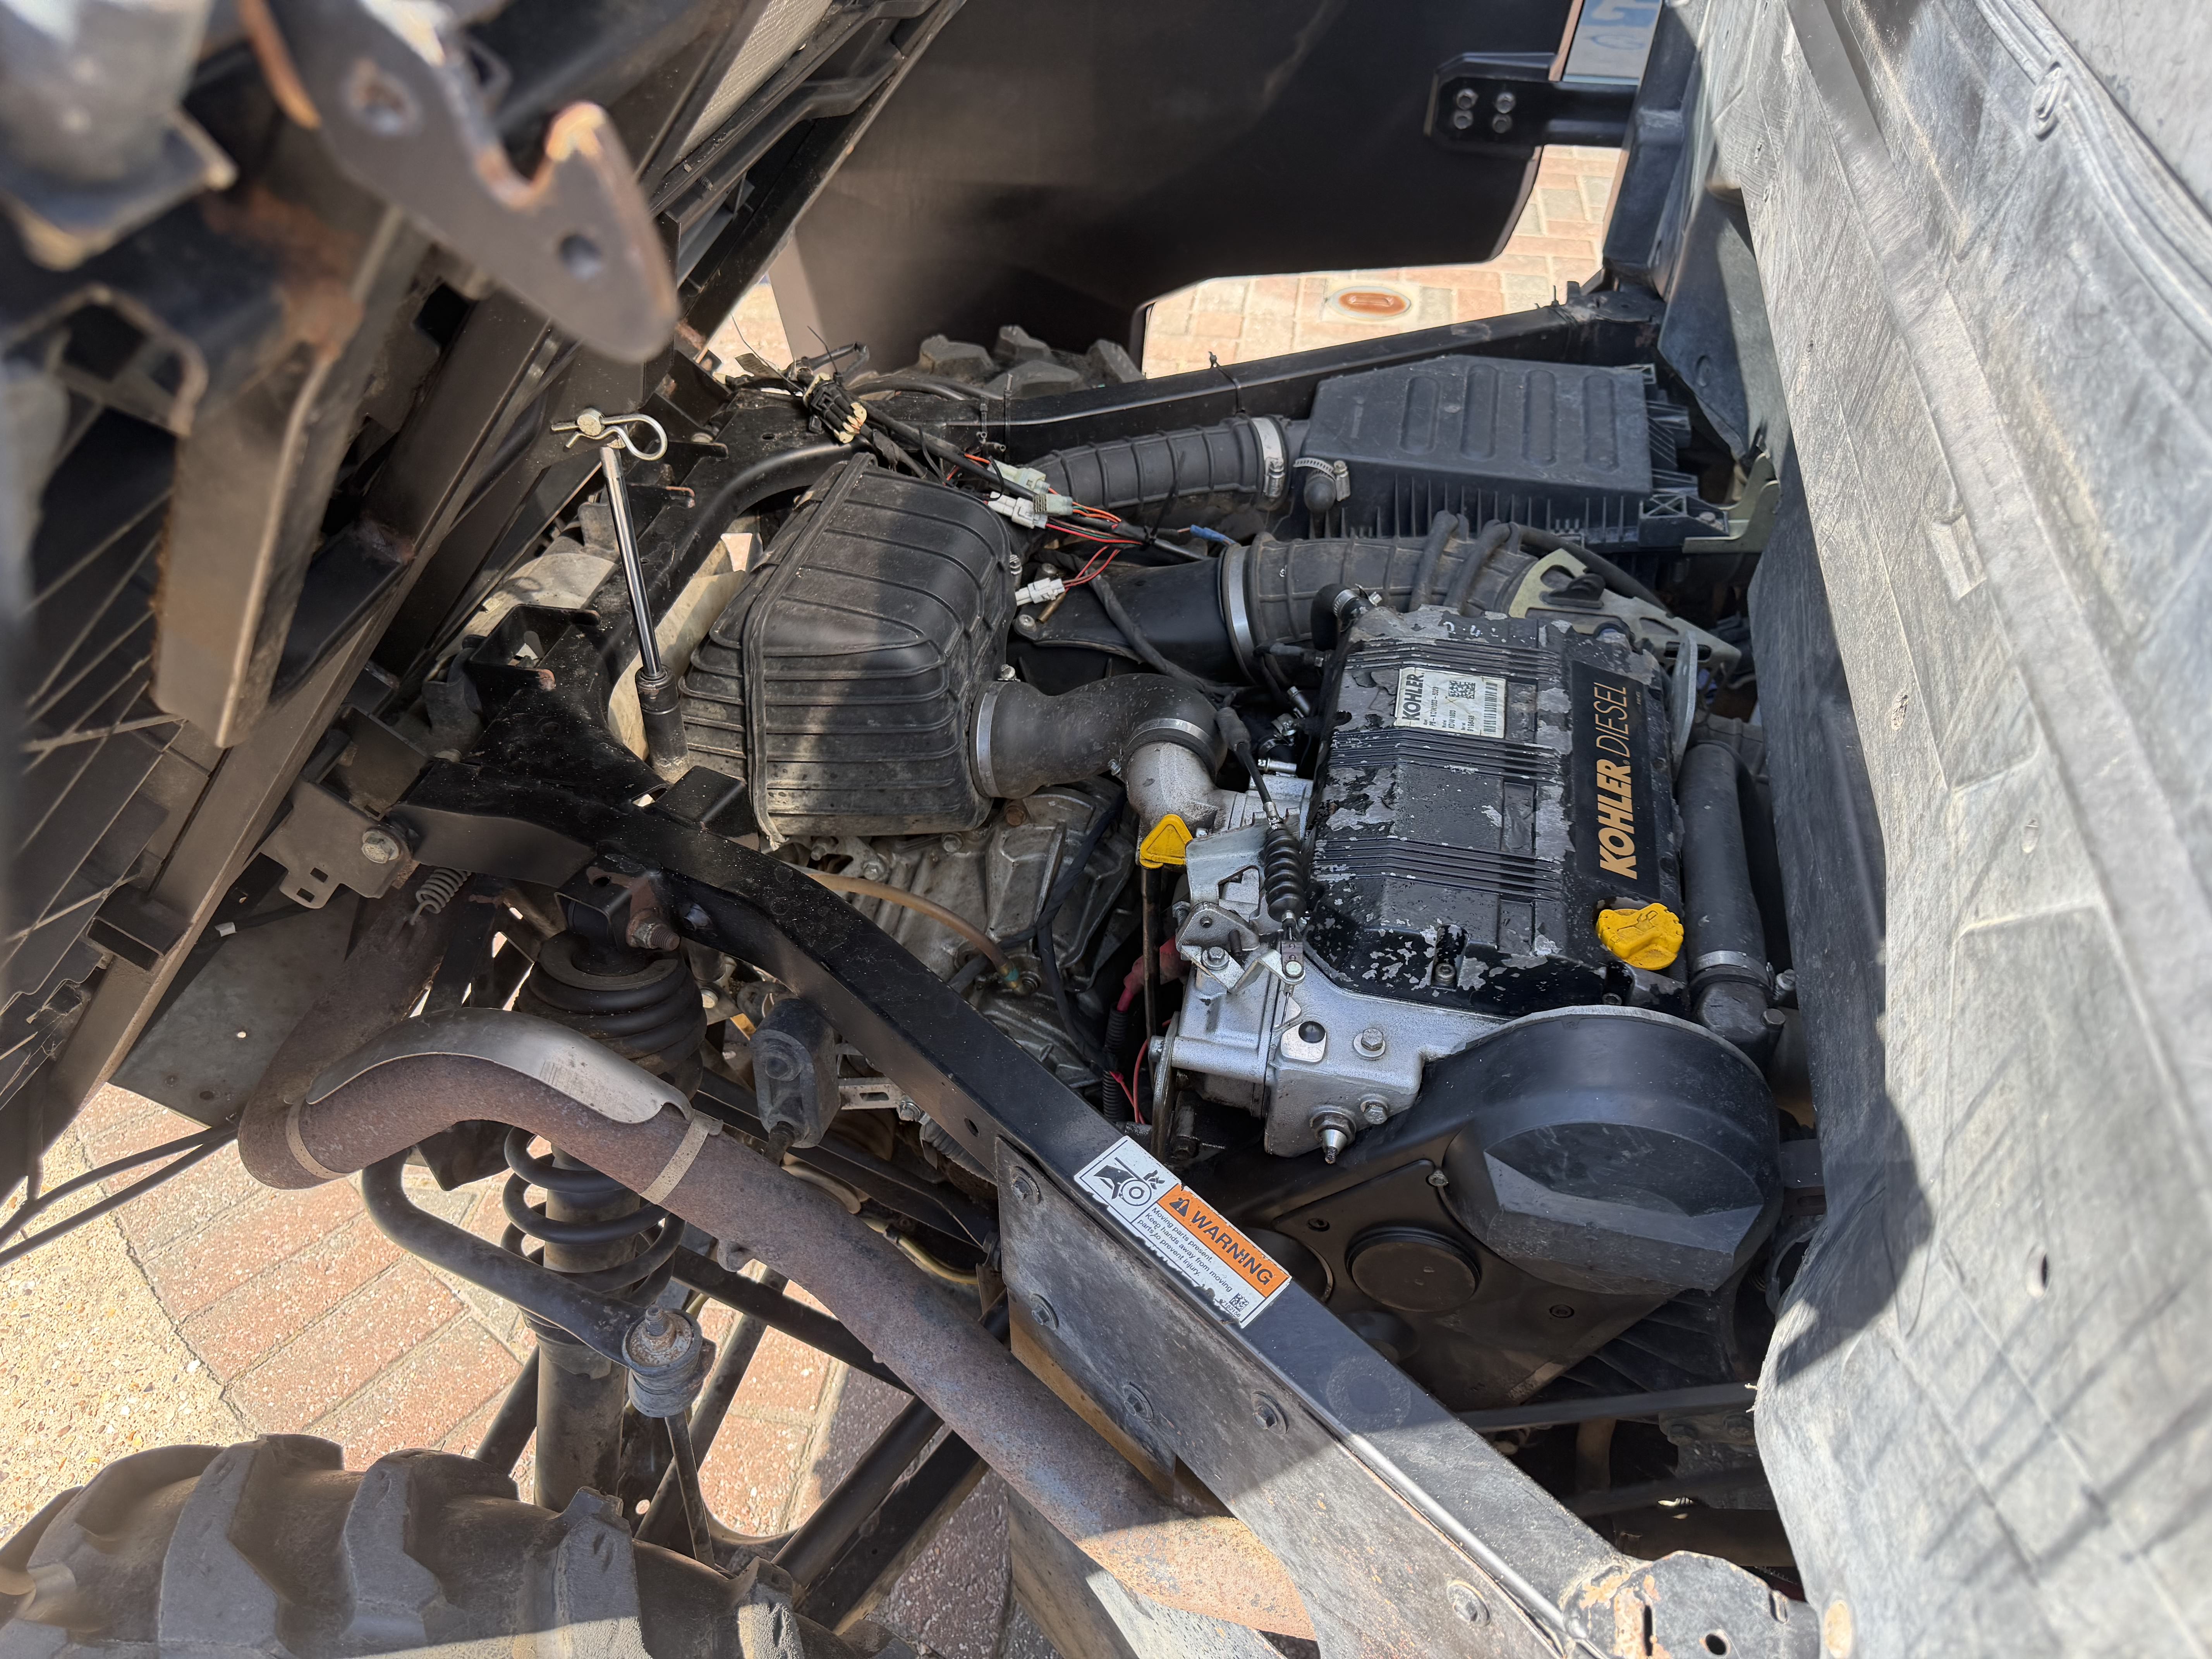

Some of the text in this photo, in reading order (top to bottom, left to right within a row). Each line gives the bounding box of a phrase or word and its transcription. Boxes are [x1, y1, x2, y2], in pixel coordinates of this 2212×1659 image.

[1594, 682, 1630, 757] DIESEL
[1137, 1219, 1154, 1234] parts
[1159, 1239, 1184, 1261] prevent
[1183, 1258, 1200, 1276] injury.
[1146, 1213, 1233, 1292] Keep hands away from moving
[1152, 1207, 1212, 1263] Moving parts present.
[1191, 1210, 1273, 1285] WARNING
